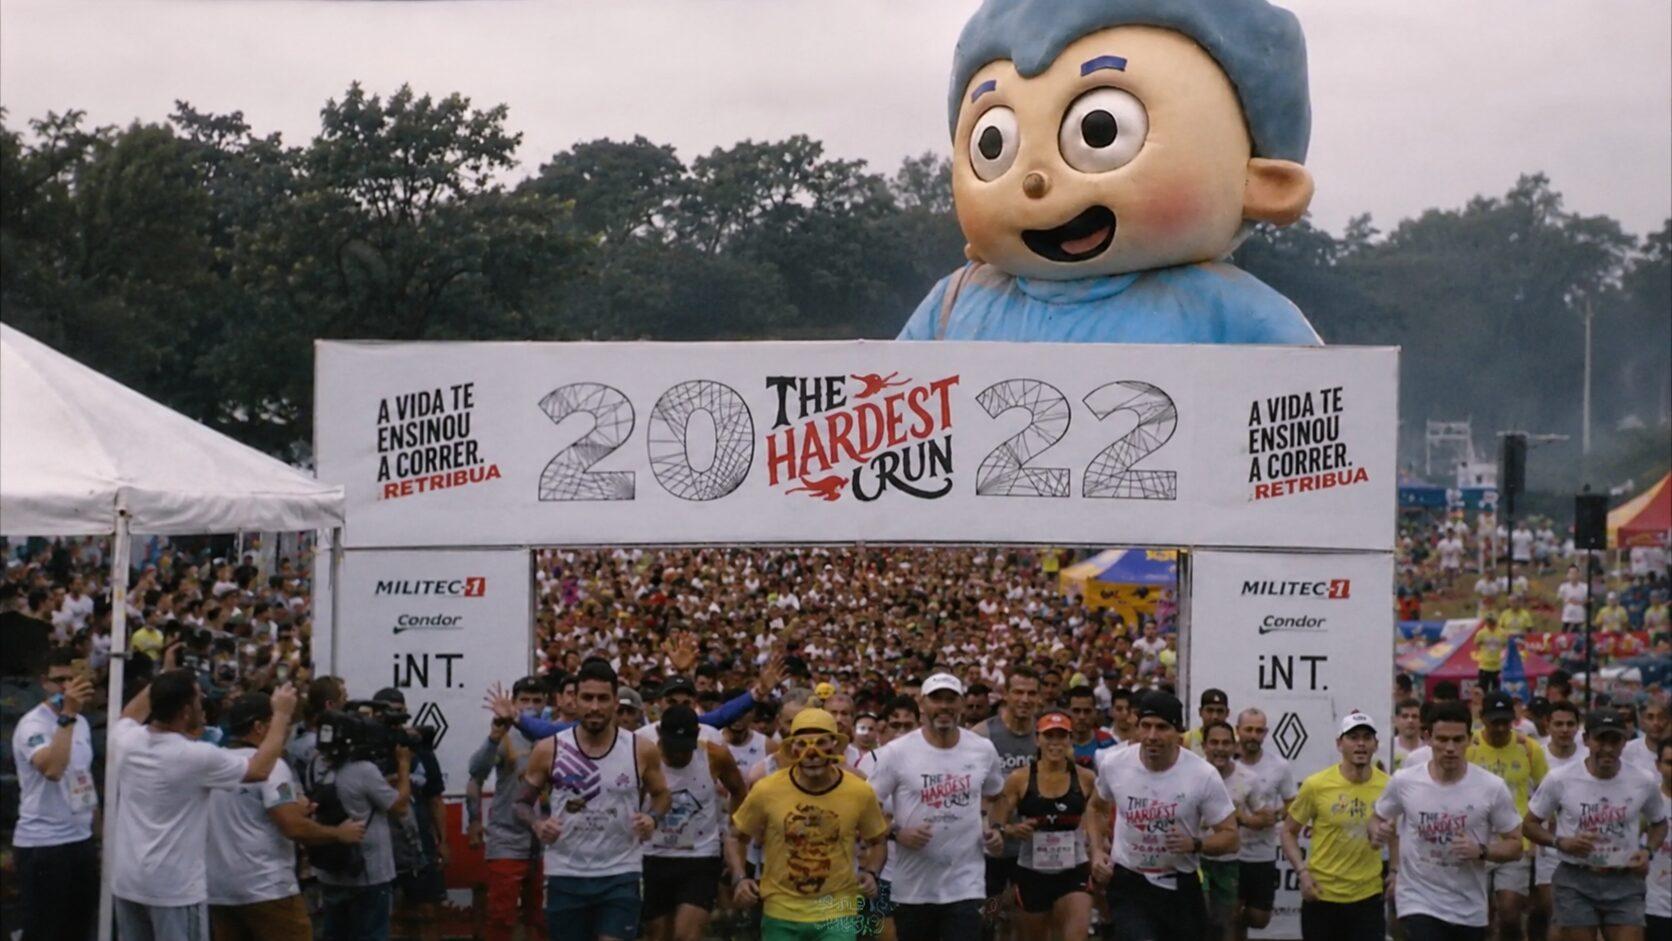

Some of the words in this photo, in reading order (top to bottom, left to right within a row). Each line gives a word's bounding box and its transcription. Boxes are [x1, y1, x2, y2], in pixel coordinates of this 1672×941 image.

[377, 398, 390, 425] A
[396, 388, 444, 421] VIDA
[450, 382, 474, 411] TE
[766, 375, 847, 430] THE
[1248, 400, 1261, 427] A
[1267, 391, 1314, 423] VIDA
[1320, 386, 1343, 415] TE
[377, 412, 470, 453] ENSINOU
[538, 379, 755, 501] 20
[766, 374, 960, 487] HARDEST
[975, 378, 1178, 500] 22
[1249, 415, 1340, 455] ENSINOU
[377, 455, 390, 482] A
[396, 439, 485, 478] CORRER.
[852, 434, 954, 502] RUN
[1248, 457, 1261, 483] A
[1267, 442, 1353, 479] CORRER.
[383, 463, 501, 500] RETRIBUA
[1255, 467, 1369, 500] RETRIBUA
[397, 613, 463, 626] Condor
[1263, 615, 1327, 628] Condor
[920, 774, 971, 803] HARDEST
[921, 774, 943, 788] THE
[1127, 796, 1148, 811] THE
